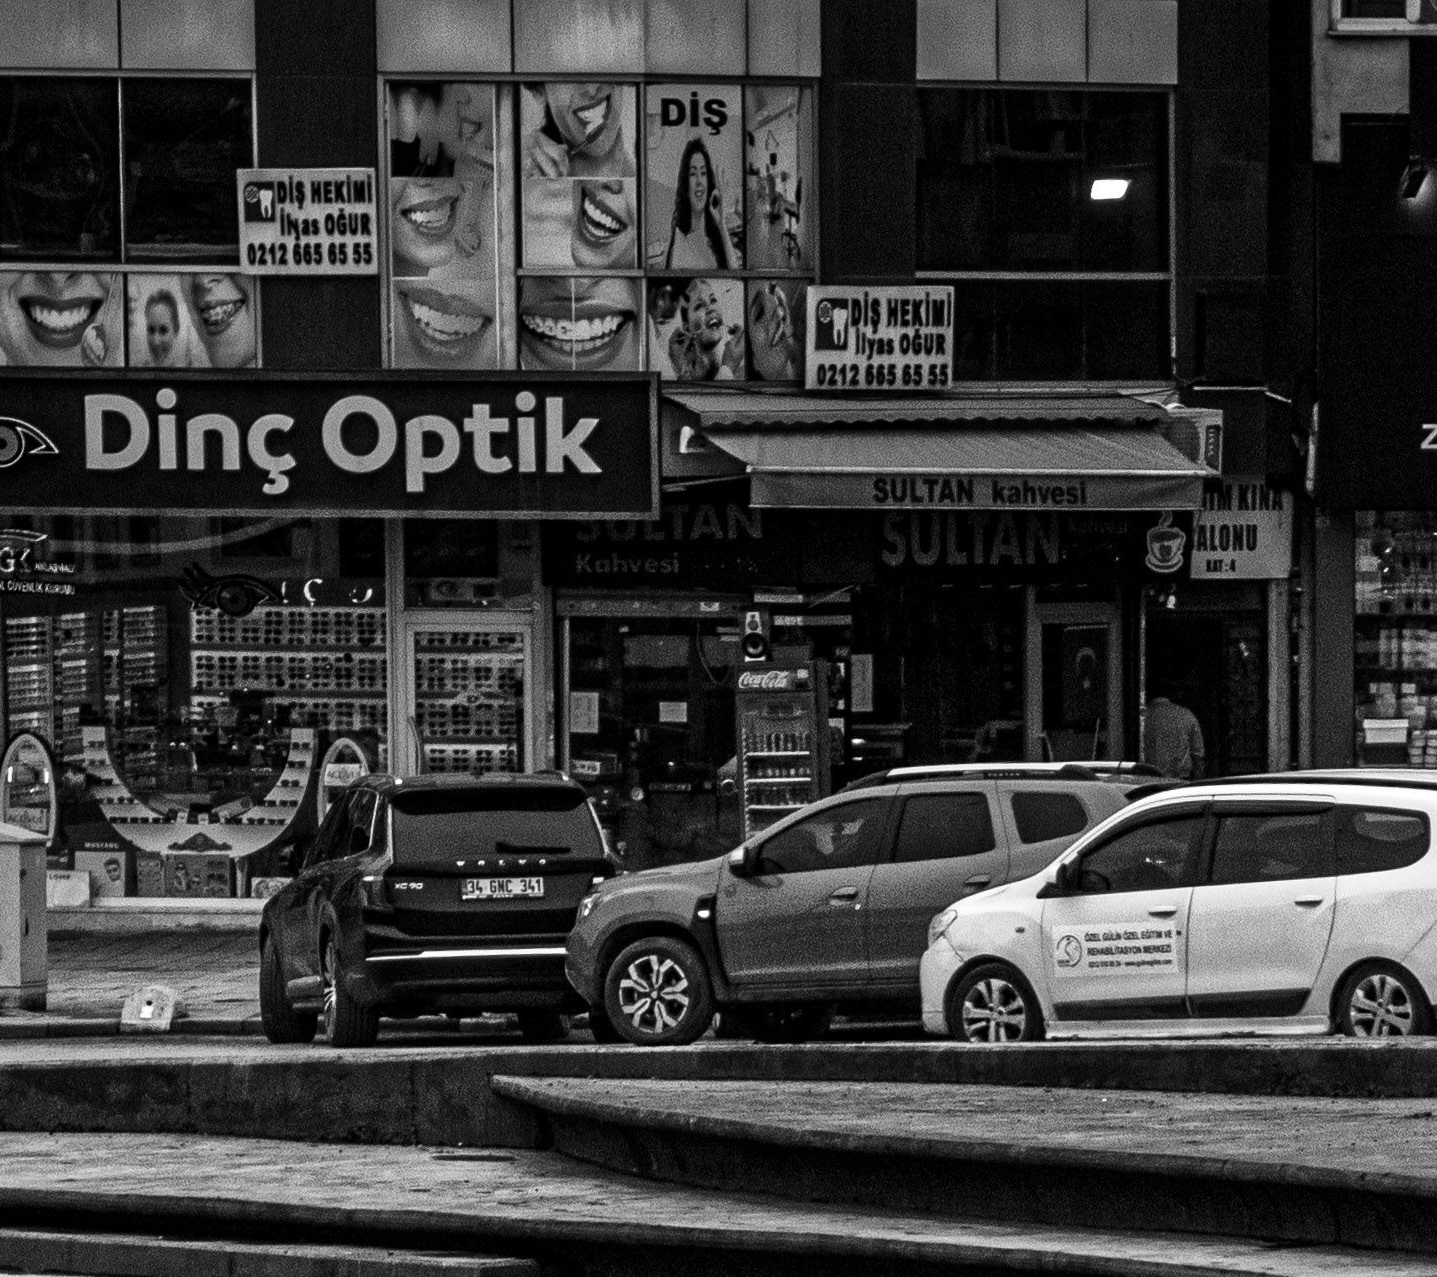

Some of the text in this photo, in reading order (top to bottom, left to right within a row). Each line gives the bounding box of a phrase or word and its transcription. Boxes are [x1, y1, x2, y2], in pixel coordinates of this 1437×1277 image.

[661, 92, 728, 135] DİŞ
[276, 175, 374, 206] DİŞ HEKİMİ
[325, 208, 372, 236] OĞUR
[248, 243, 374, 266] 0212 665 65 55
[851, 291, 953, 332] DİŞ HEKİMİ
[855, 331, 946, 359] İlyas OĞUR
[817, 363, 949, 386] 0212 665 65 55
[84, 387, 603, 495] Dinç Optik
[874, 478, 1088, 505] SULTAN kahvesi
[881, 512, 1060, 567] SULTAN
[1196, 524, 1257, 552] ALONU
[575, 553, 680, 574] Kahvesi
[467, 879, 542, 894] 34 GNC 341
